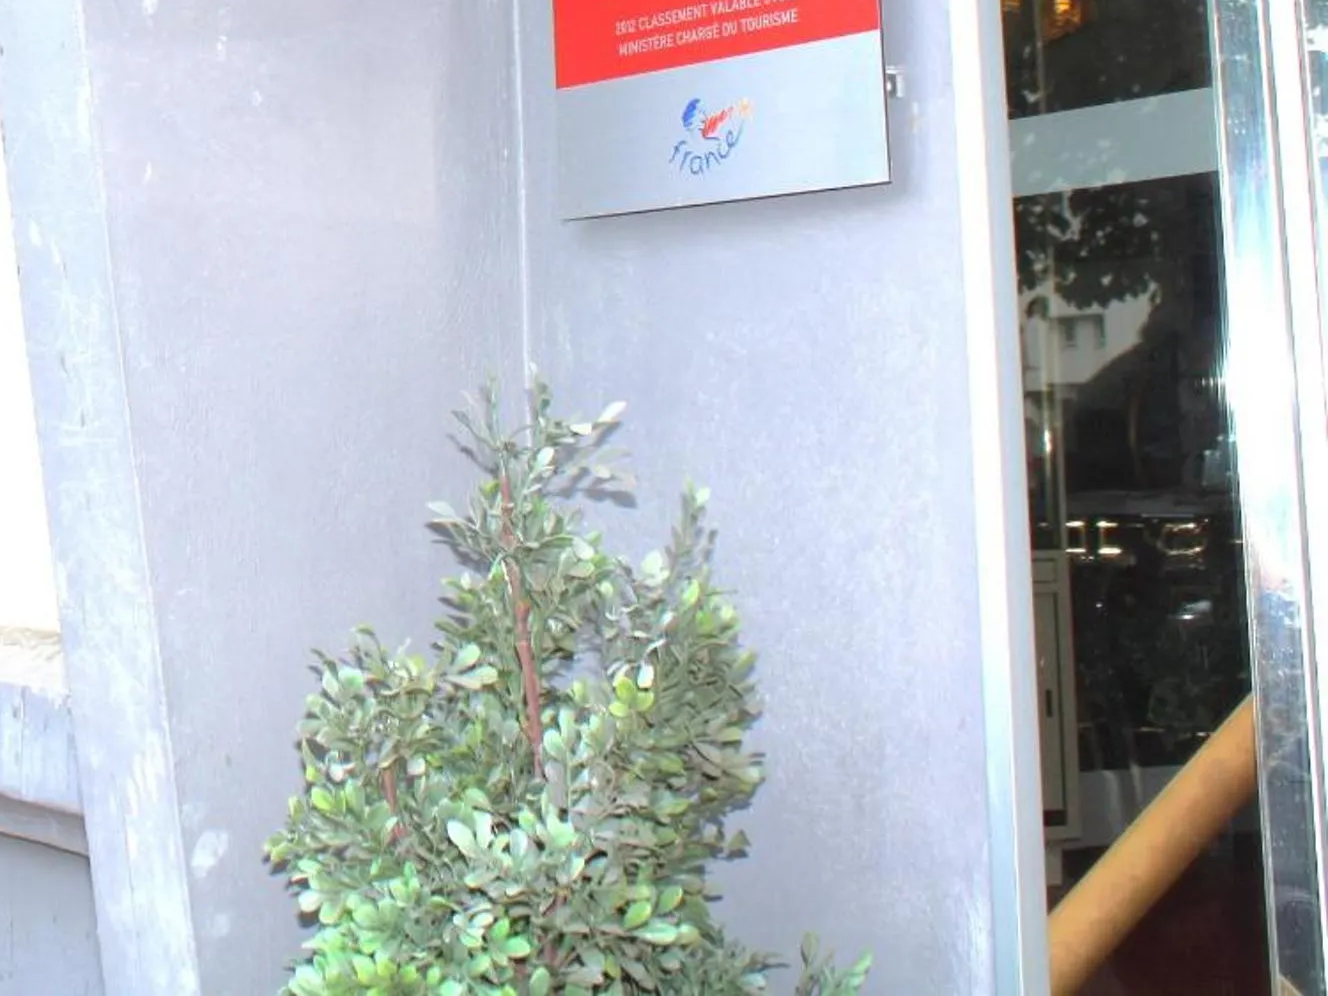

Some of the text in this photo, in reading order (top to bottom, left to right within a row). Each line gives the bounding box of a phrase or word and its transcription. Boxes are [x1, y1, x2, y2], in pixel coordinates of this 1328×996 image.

[638, 4, 709, 32] CLASSEMENT
[722, 20, 739, 37] DU
[739, 9, 799, 33] TOURISME
